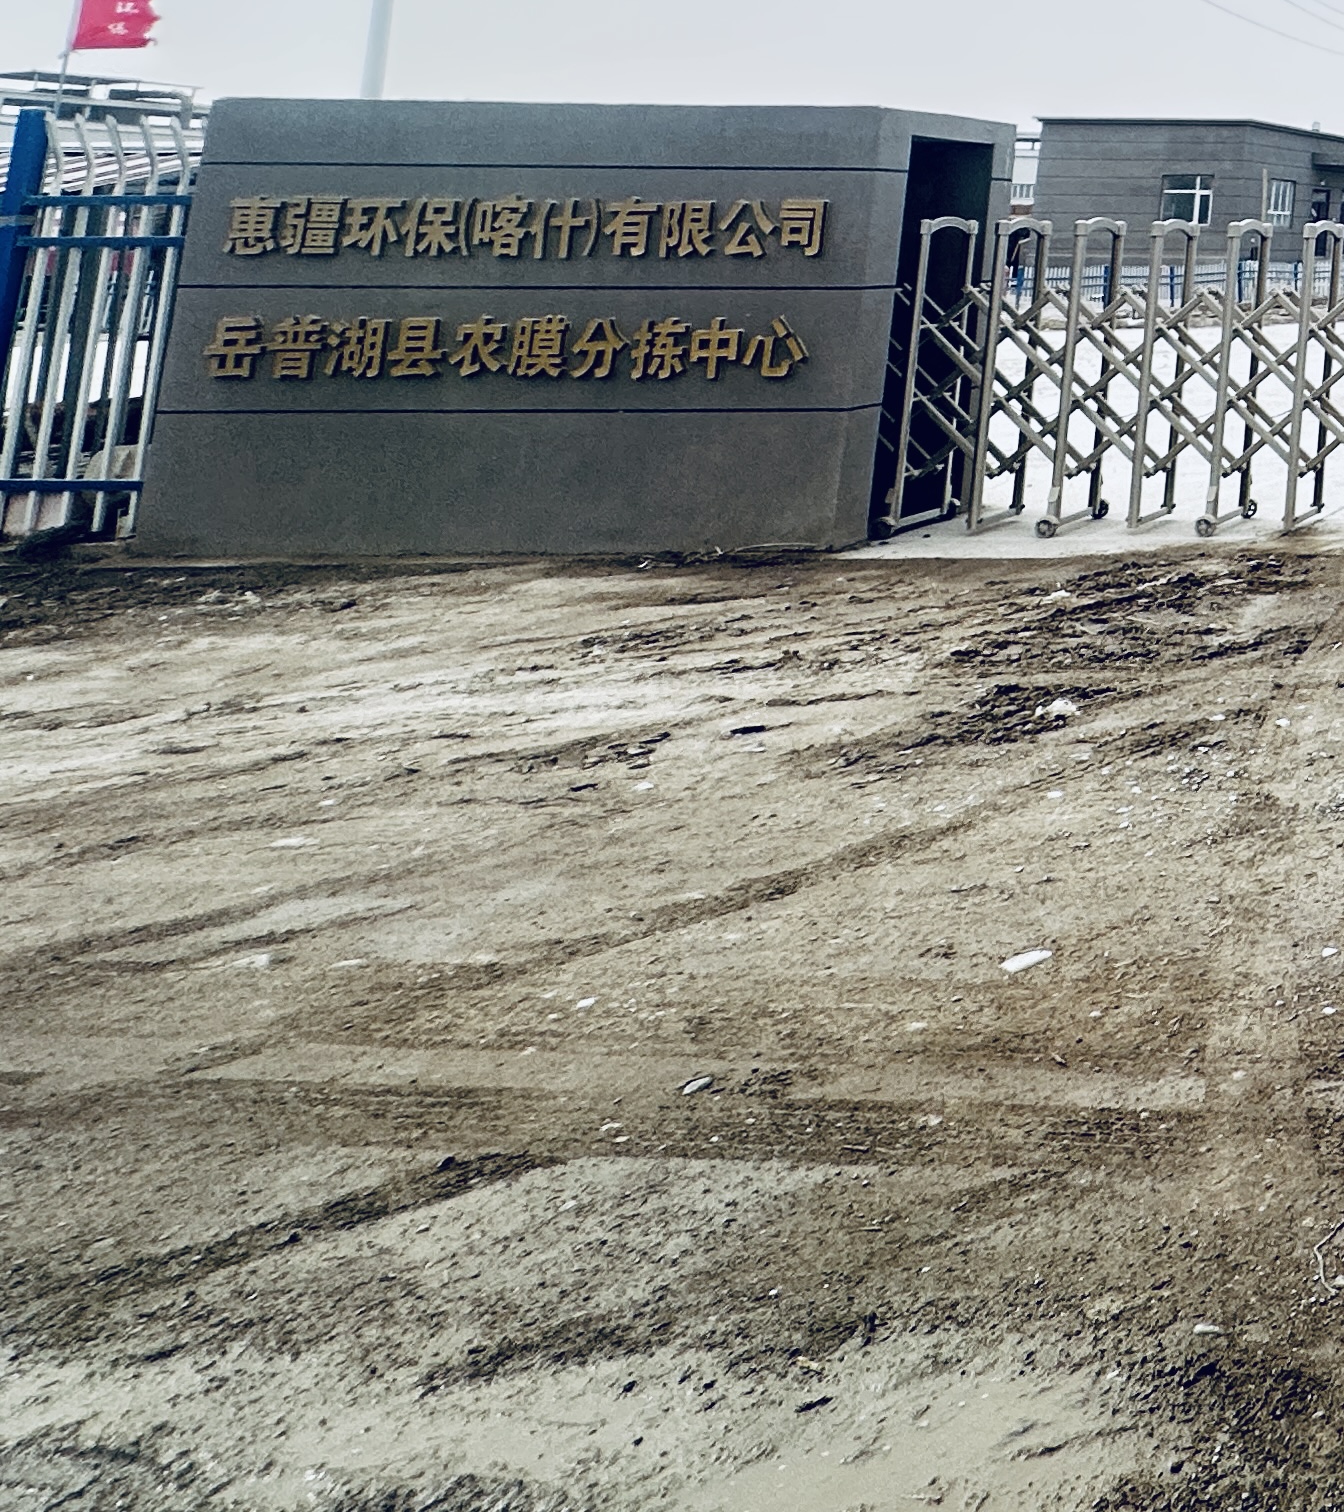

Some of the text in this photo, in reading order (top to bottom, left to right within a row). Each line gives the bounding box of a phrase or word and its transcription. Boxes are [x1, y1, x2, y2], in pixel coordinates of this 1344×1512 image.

[222, 195, 830, 259] 惠疆环保(喀什)有限公司
[201, 315, 809, 379] 岳普湖县农膜分拣中心
